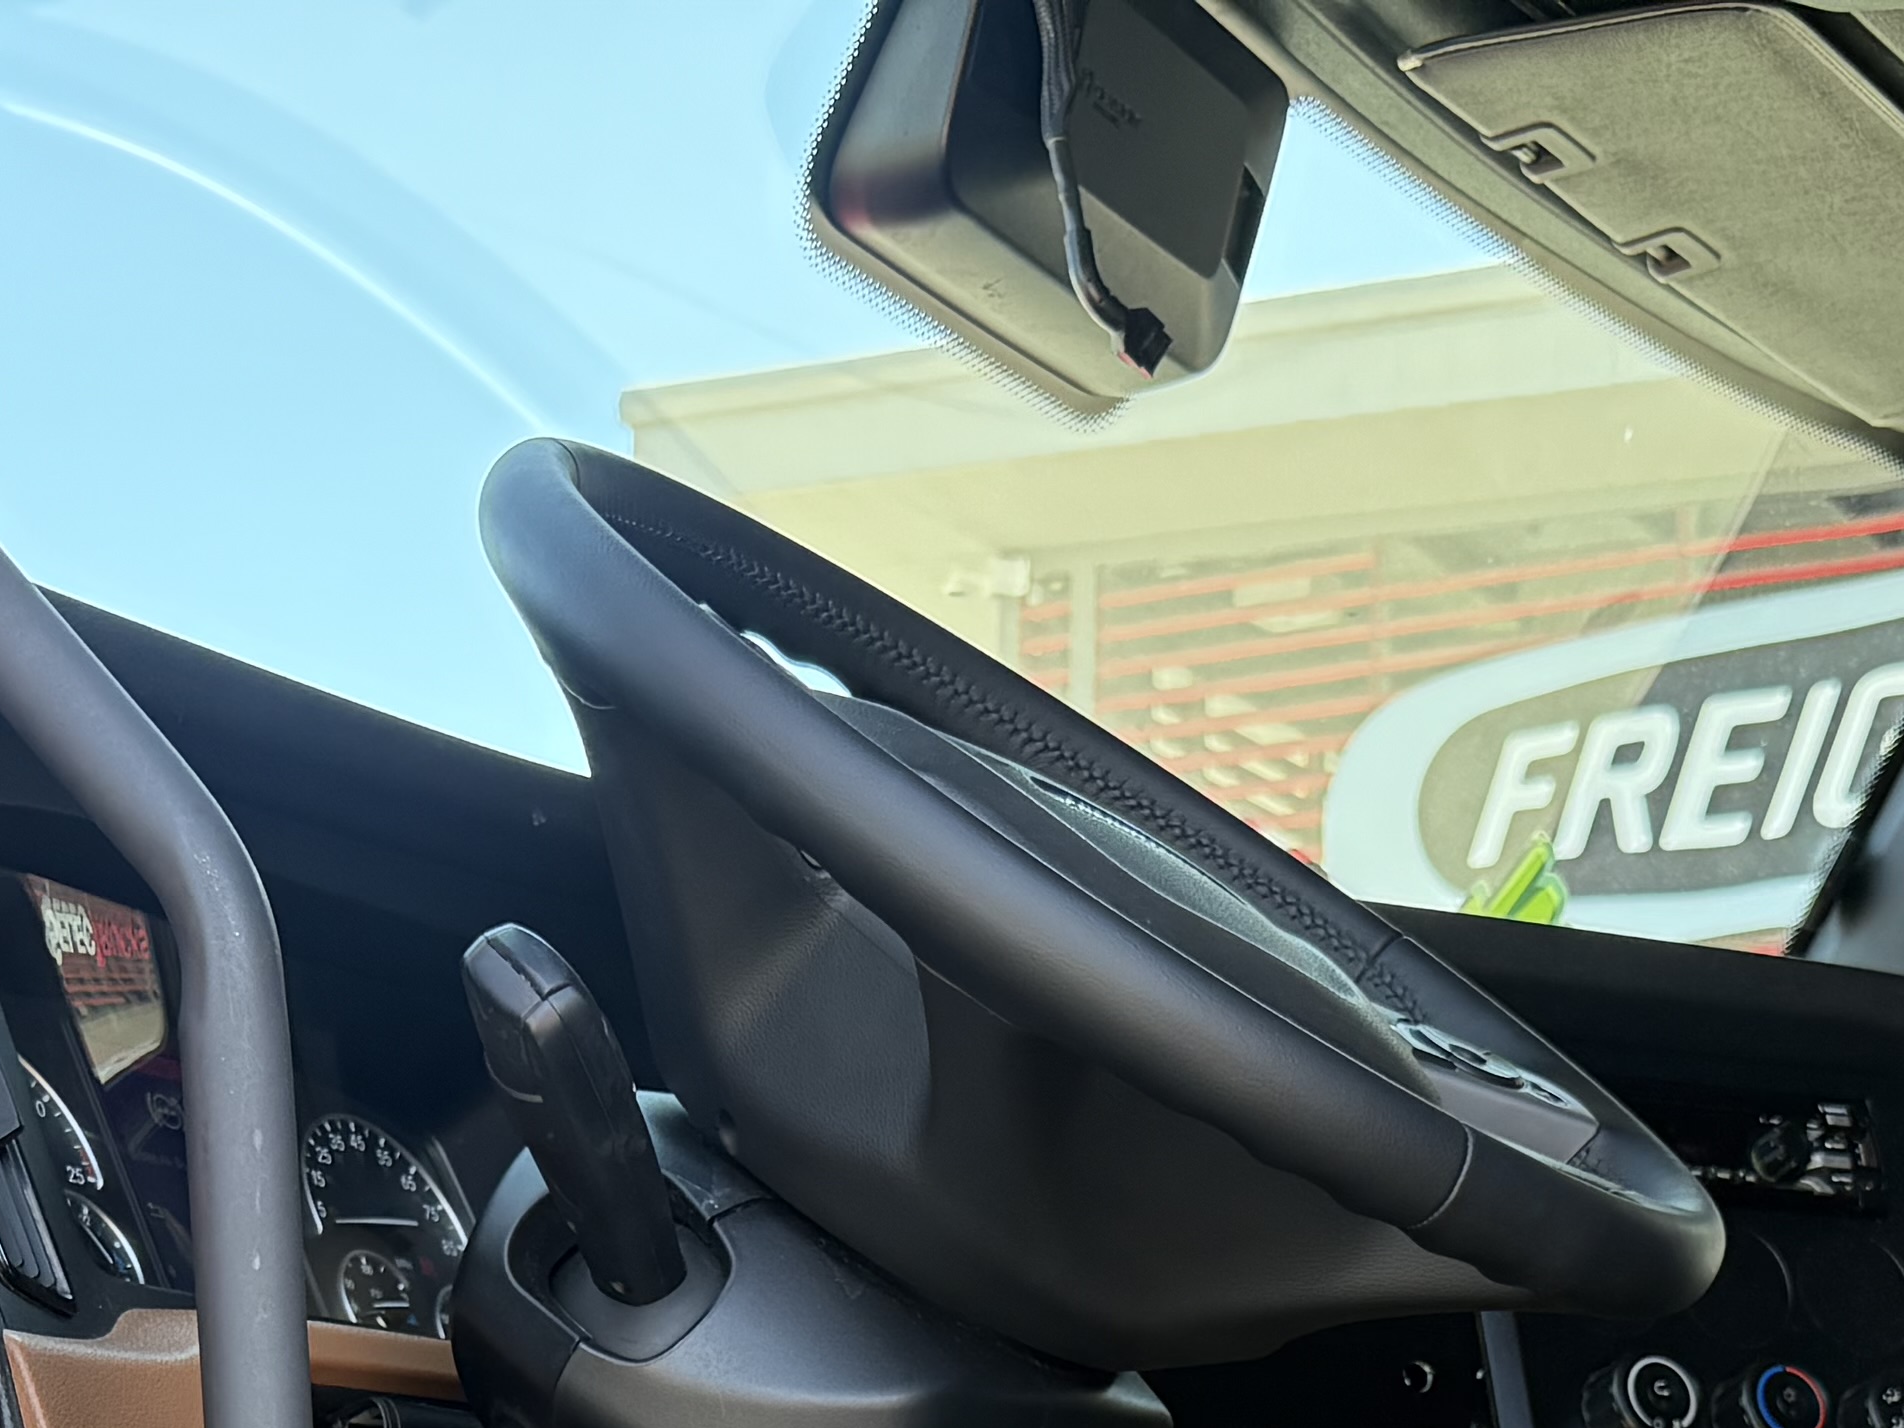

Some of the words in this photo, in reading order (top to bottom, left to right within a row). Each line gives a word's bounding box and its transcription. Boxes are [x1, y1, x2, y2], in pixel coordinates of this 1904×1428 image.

[329, 1133, 345, 1151] 35
[350, 1133, 366, 1151] 45
[316, 1147, 332, 1164] 25
[376, 1148, 393, 1167] 55
[66, 1165, 86, 1185] 25
[311, 1170, 326, 1188] 15
[400, 1174, 416, 1192] 65
[317, 1200, 327, 1218] 5
[422, 1204, 440, 1222] 75
